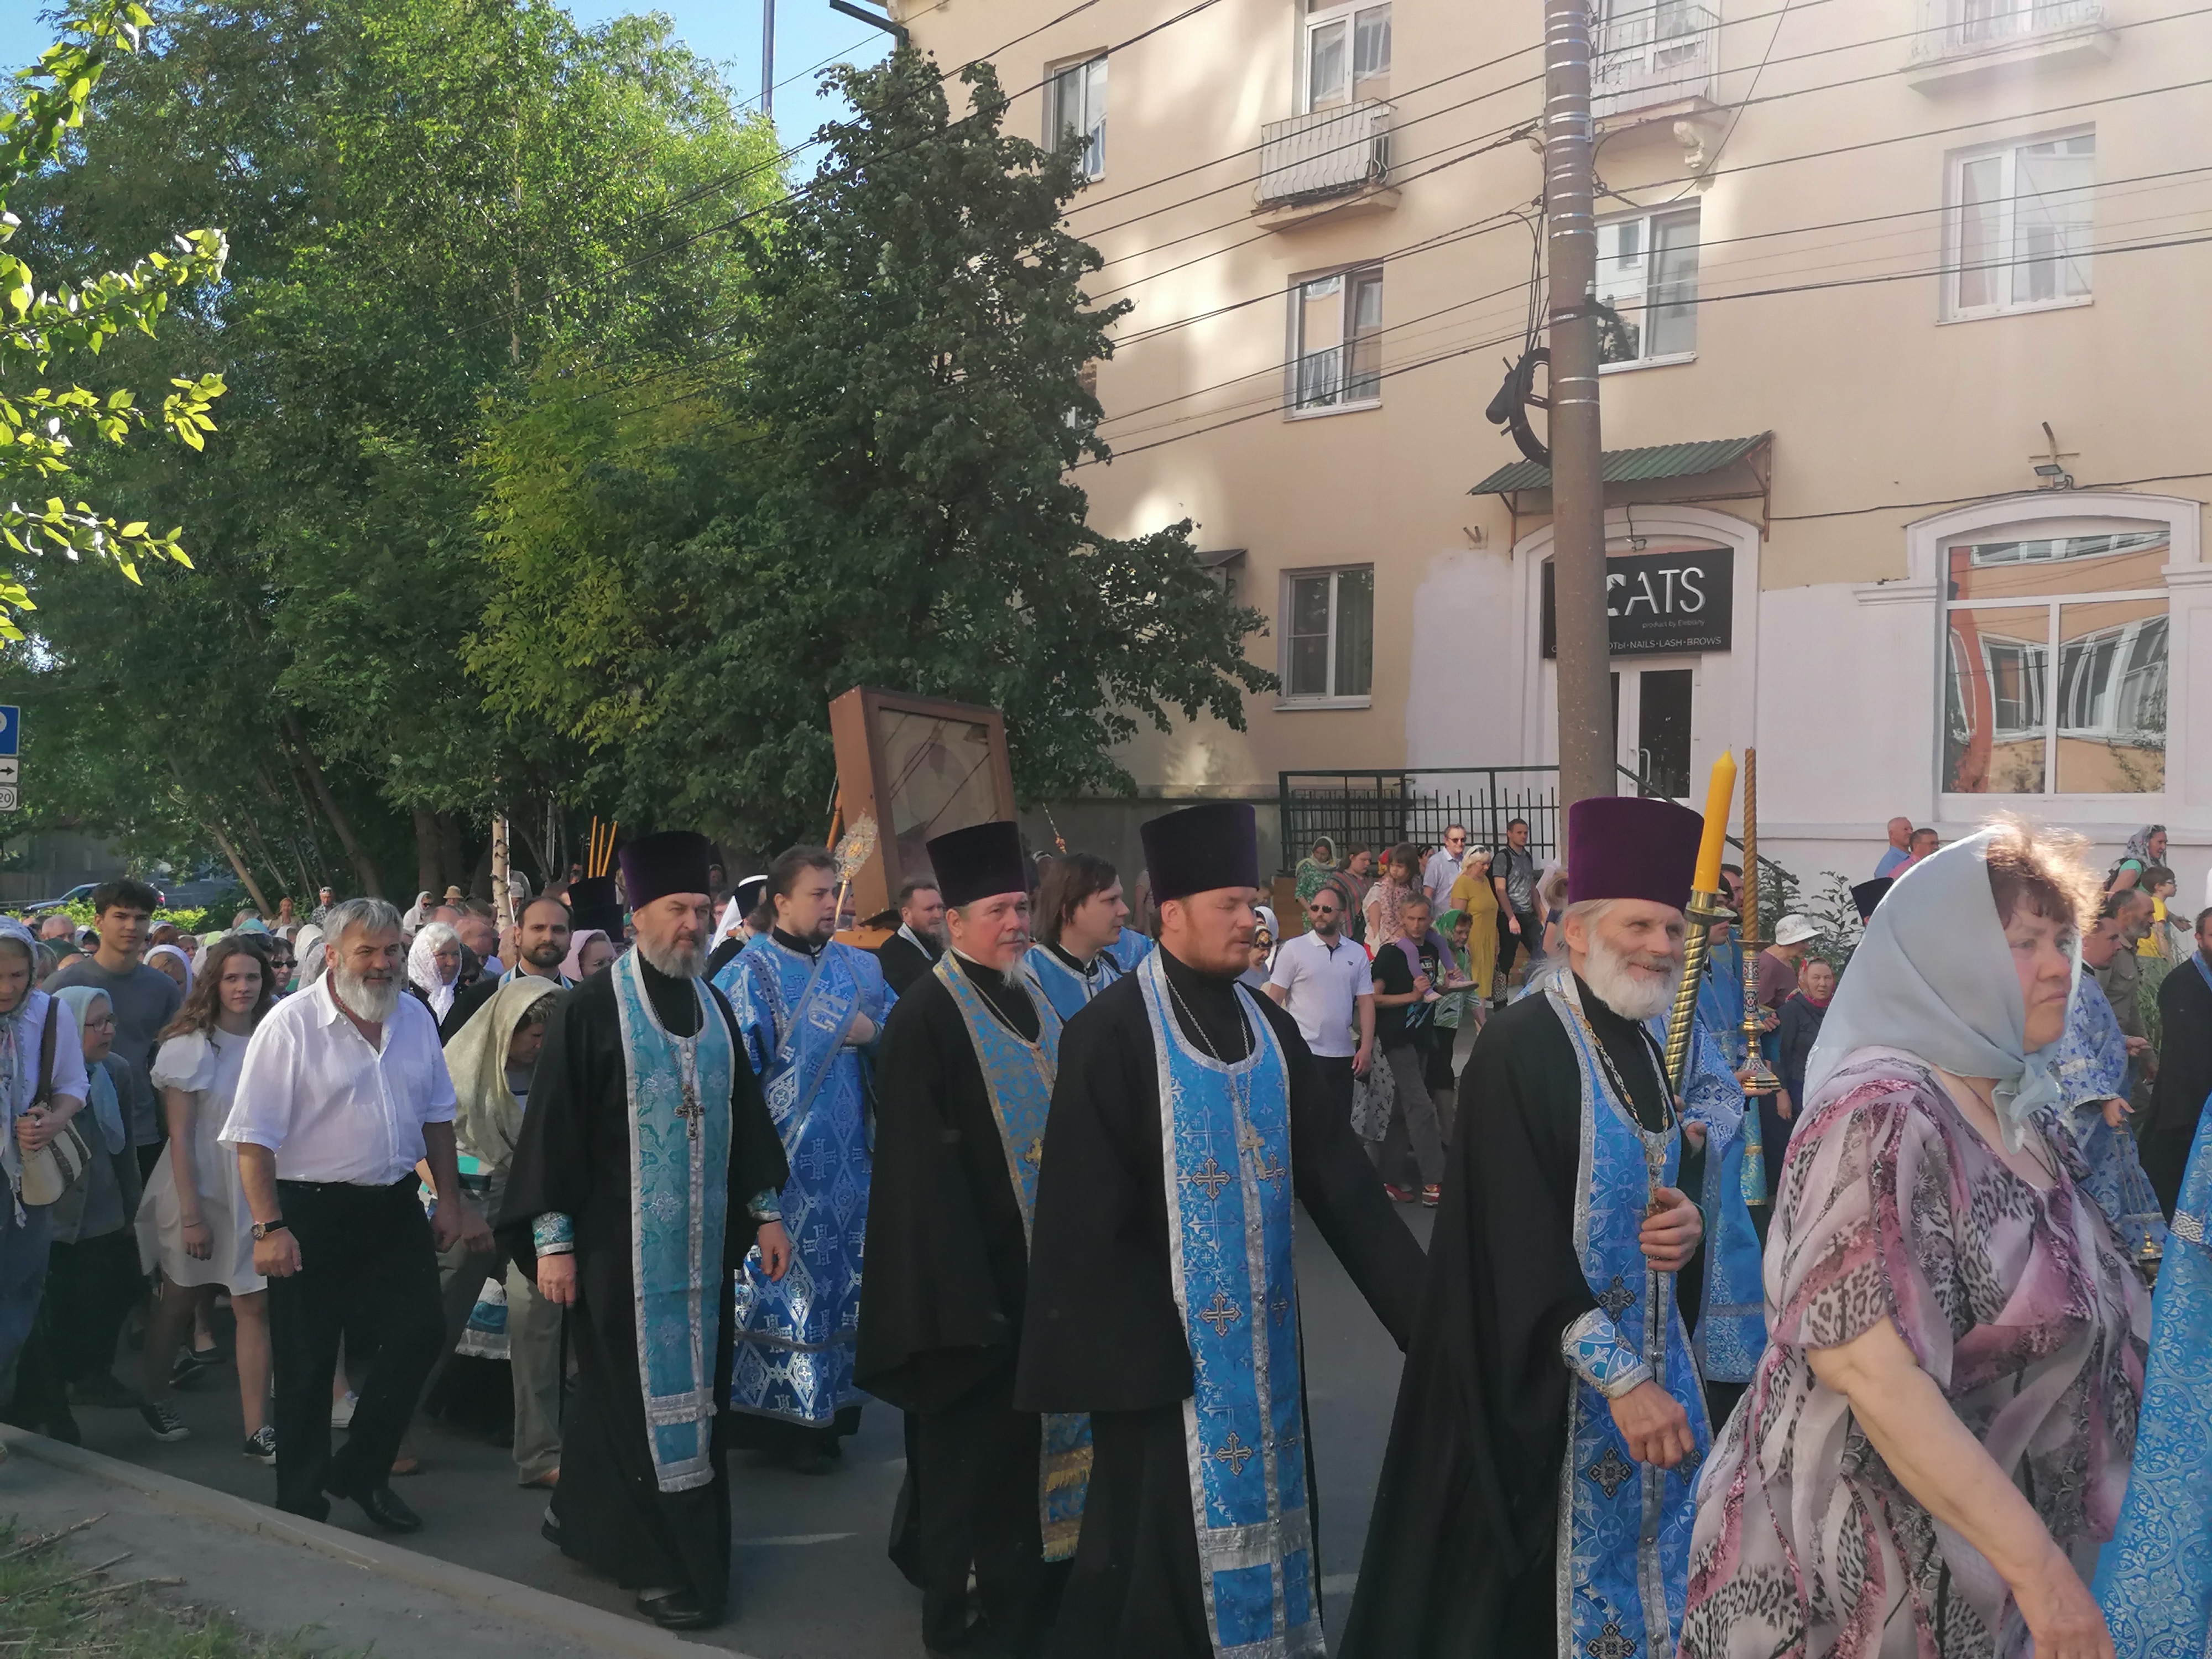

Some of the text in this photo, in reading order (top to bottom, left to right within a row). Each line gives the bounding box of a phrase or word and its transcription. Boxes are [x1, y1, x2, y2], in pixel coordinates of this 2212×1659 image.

[1630, 640, 1656, 649] NAILS
[1660, 639, 1683, 648] LASH
[1687, 636, 1722, 646] BROWS
